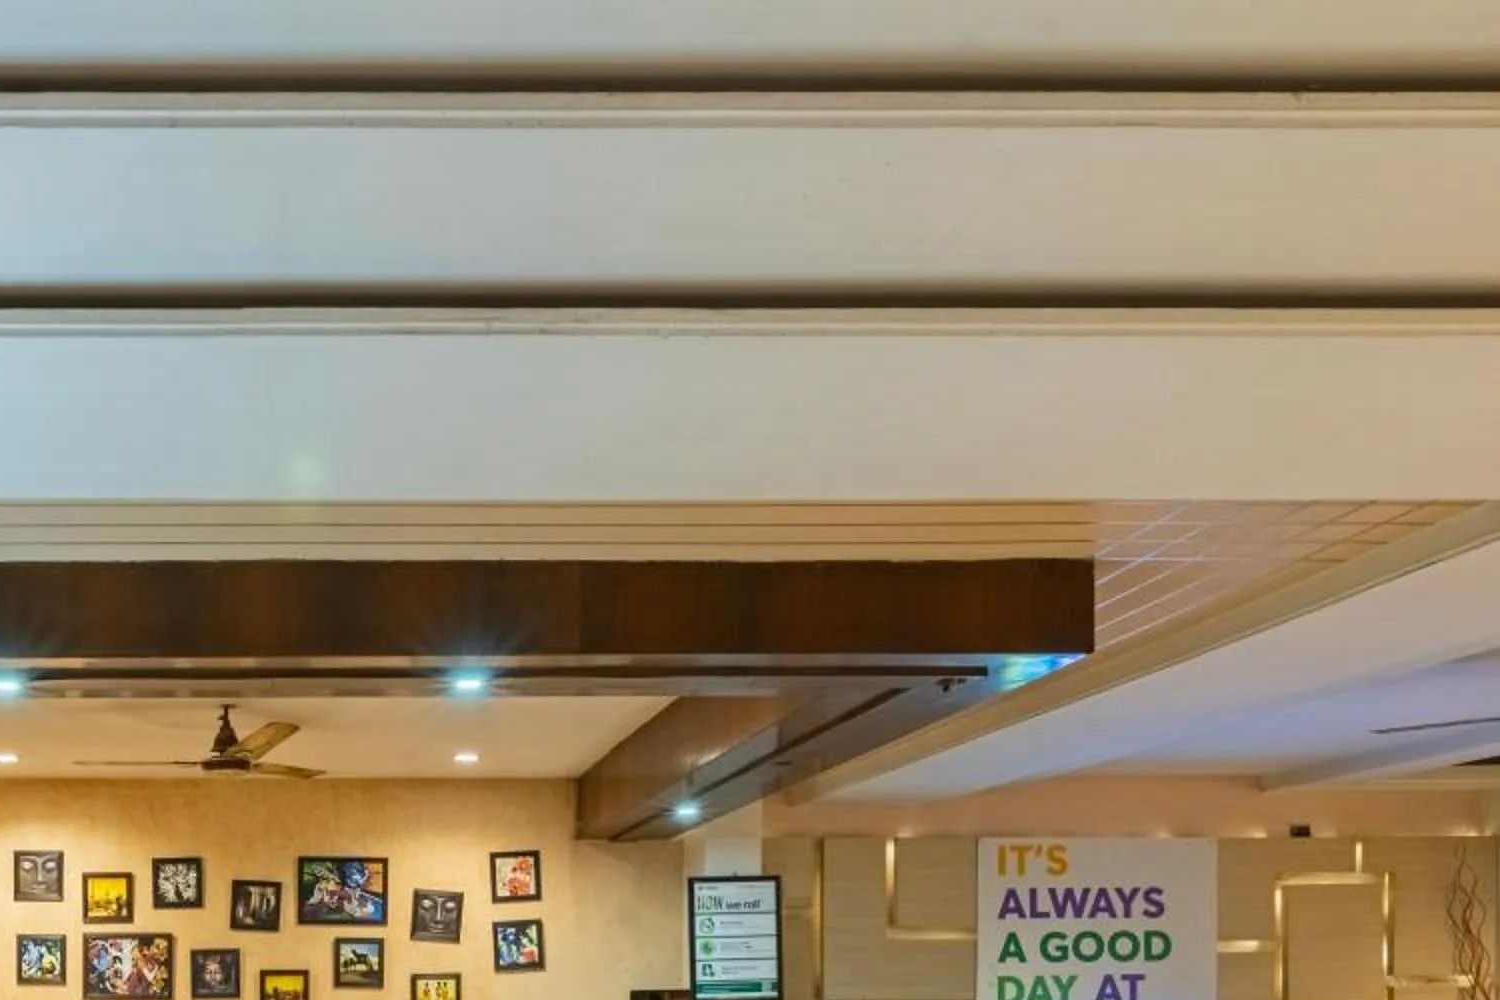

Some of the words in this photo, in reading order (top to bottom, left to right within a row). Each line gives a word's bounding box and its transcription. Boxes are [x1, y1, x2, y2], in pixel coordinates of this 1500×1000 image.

[997, 845, 1068, 877] IT'S
[997, 887, 1165, 919] ALWAYS
[997, 932, 1027, 963] A
[1039, 931, 1173, 962] GOOD
